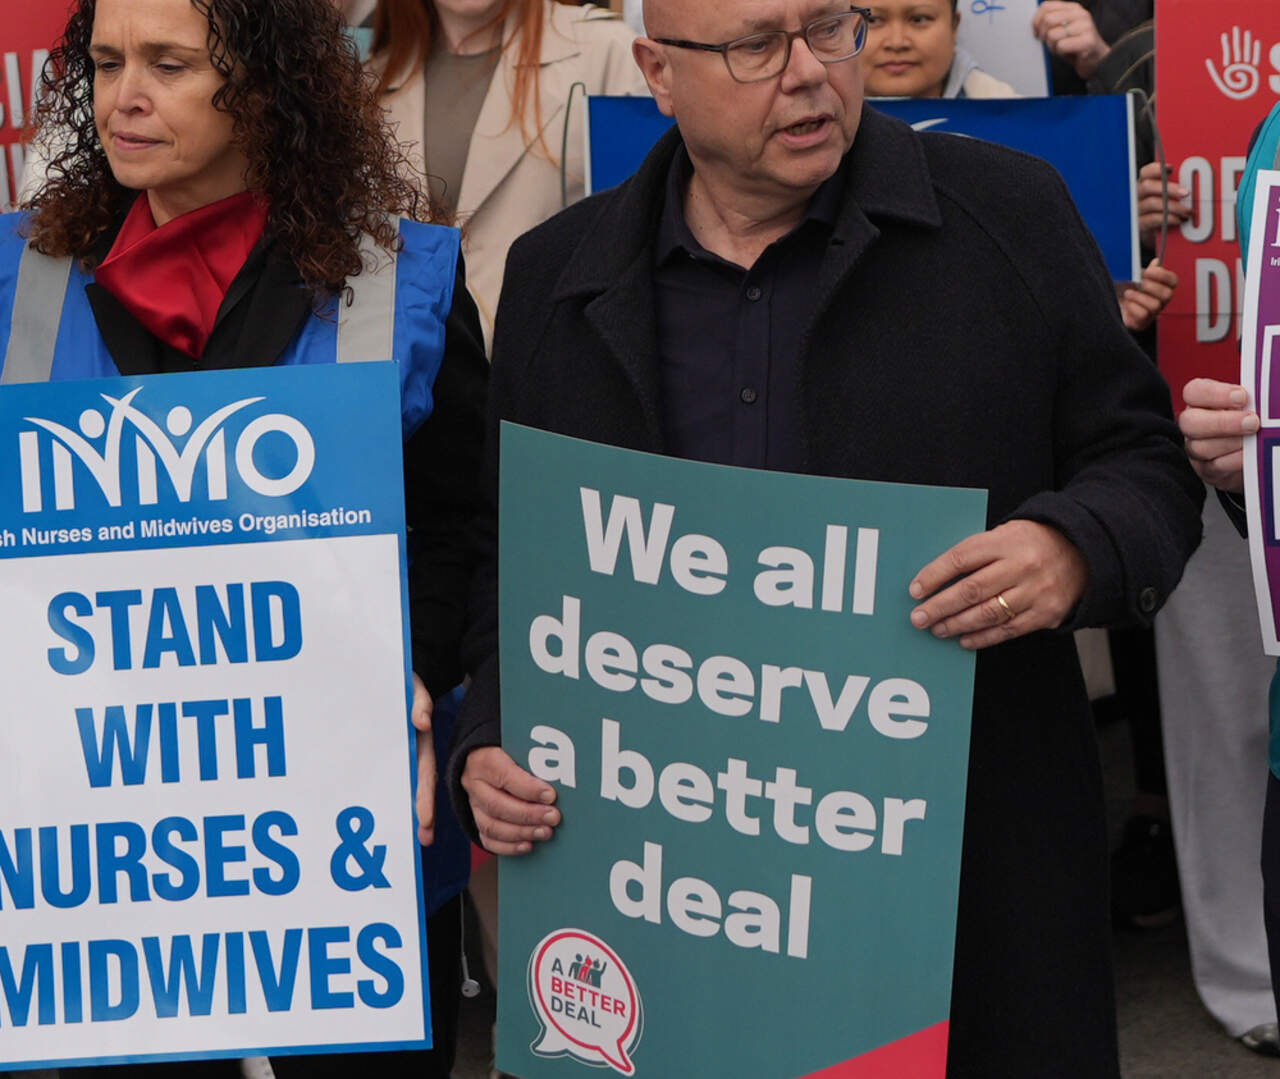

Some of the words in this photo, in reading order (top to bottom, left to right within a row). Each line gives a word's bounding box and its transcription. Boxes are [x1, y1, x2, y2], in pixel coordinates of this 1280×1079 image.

[18, 386, 315, 513] INMO
[21, 525, 90, 548] Nurses
[97, 522, 135, 542] and
[140, 518, 234, 540] Midwives
[238, 506, 372, 536] Organisation
[579, 486, 729, 597] We
[752, 523, 880, 616] all
[47, 580, 303, 677] STAND
[528, 594, 931, 740] deserve
[75, 695, 287, 788] WITH
[527, 724, 577, 789] a
[599, 717, 928, 856] better
[329, 805, 392, 893] &
[609, 841, 813, 960] deal
[551, 956, 565, 976] A
[551, 976, 627, 1019] BETTER
[551, 996, 602, 1029] DEAL
